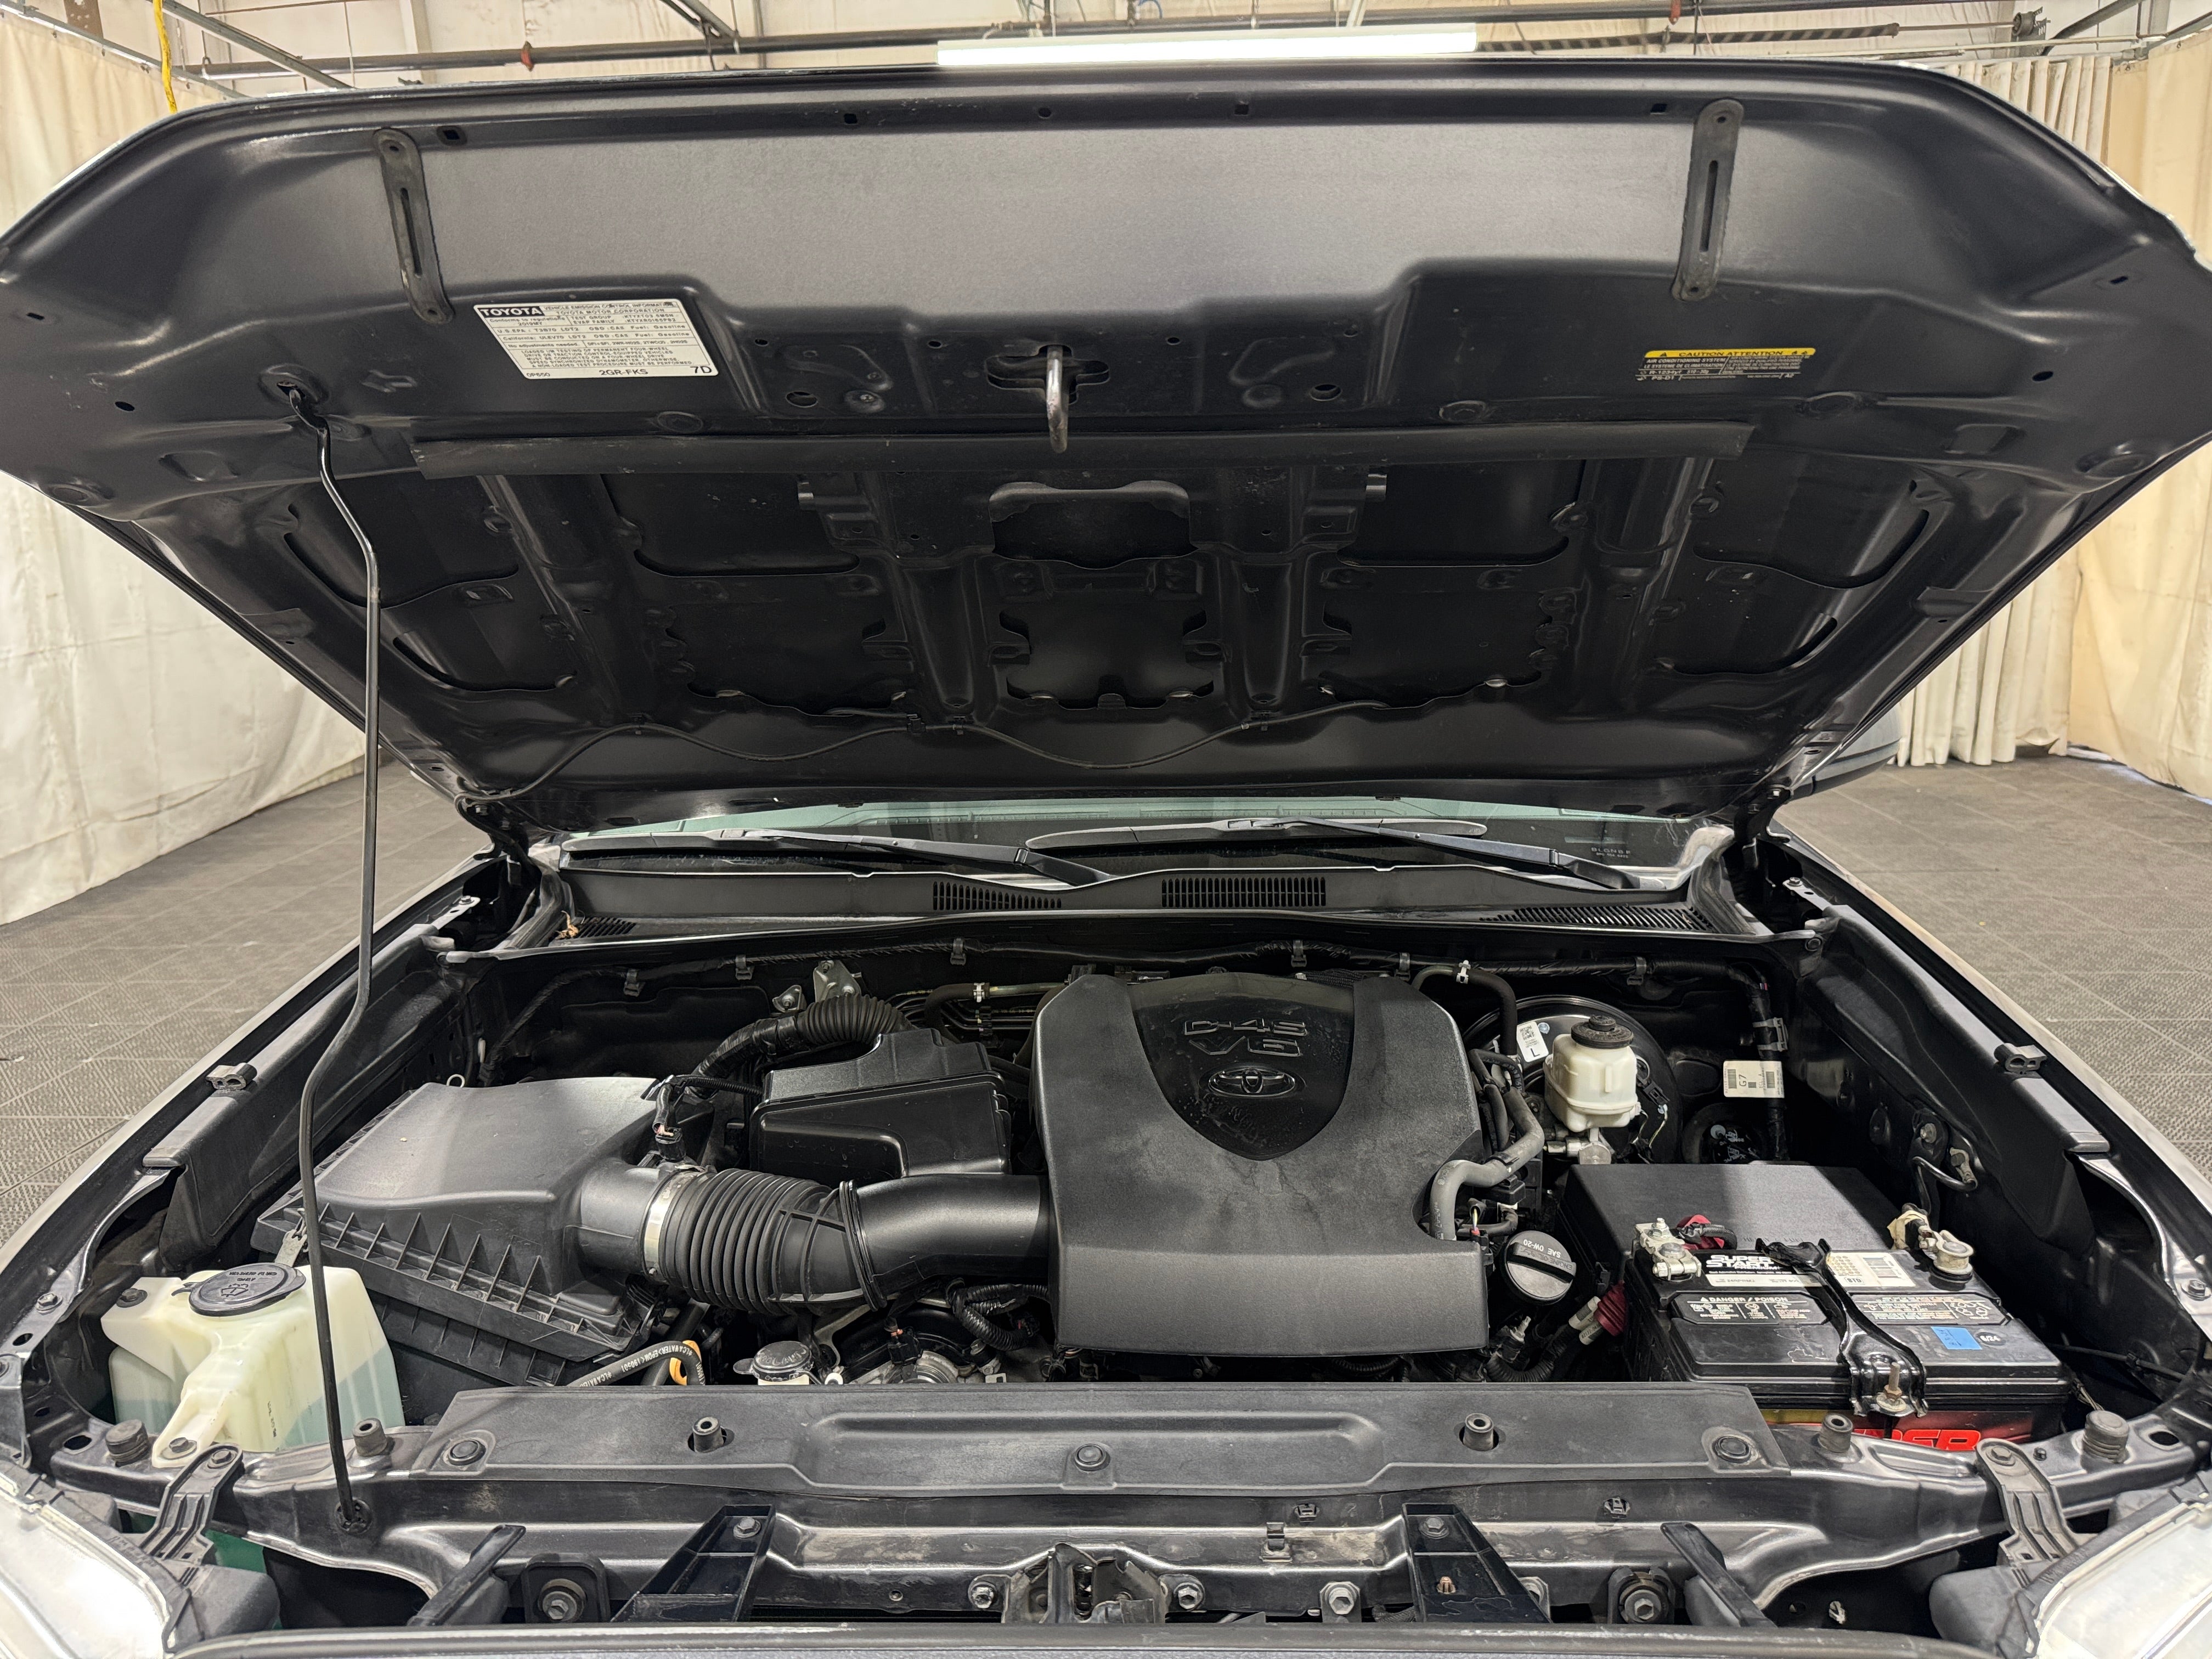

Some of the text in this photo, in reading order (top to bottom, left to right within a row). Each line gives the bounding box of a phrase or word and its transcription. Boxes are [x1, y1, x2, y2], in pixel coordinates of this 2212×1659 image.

[480, 307, 543, 316] TOYOTA
[690, 365, 712, 374] 7D
[1184, 1018, 1309, 1036] D-4S
[1188, 1035, 1301, 1057] V6
[1530, 1048, 1541, 1057] L
[1738, 1074, 1747, 1087] G7
[1523, 1239, 1561, 1258] SAE 0W-20
[1538, 1254, 1573, 1271] ENGINE OIL
